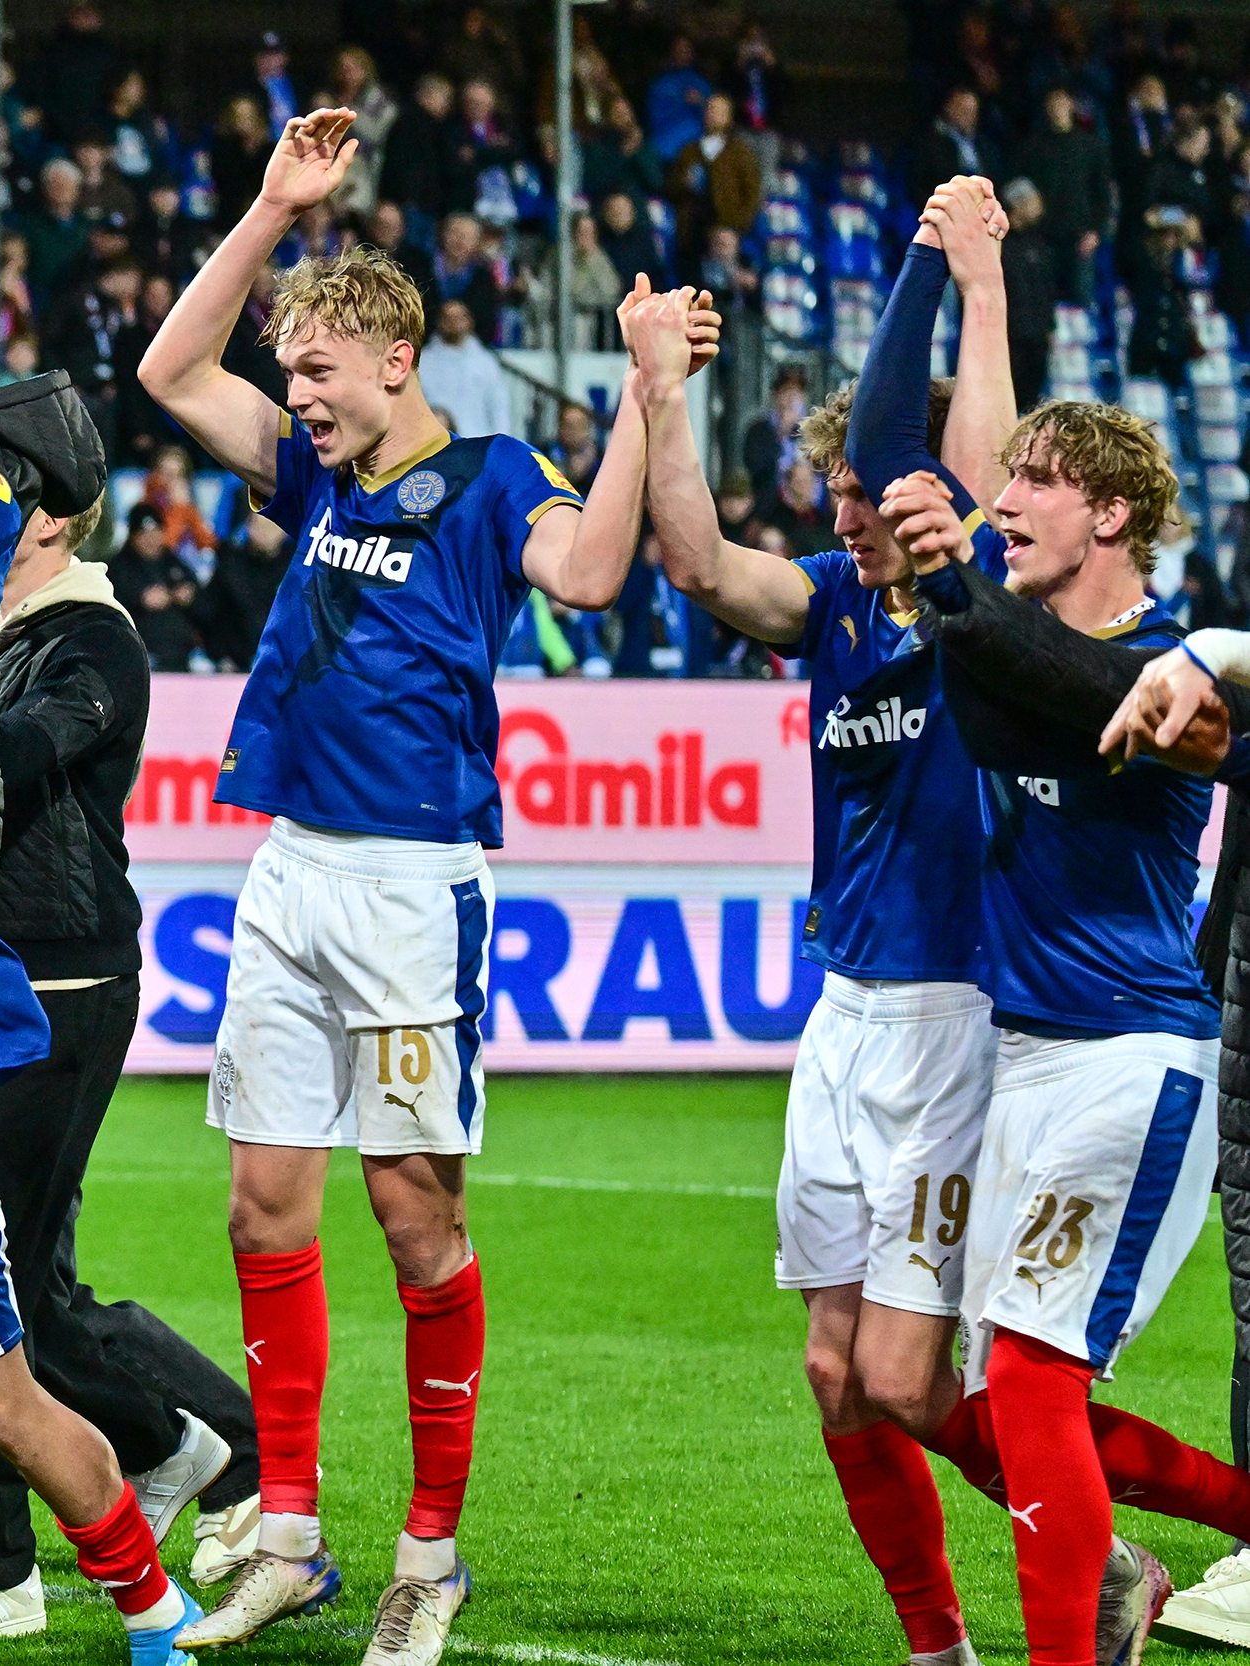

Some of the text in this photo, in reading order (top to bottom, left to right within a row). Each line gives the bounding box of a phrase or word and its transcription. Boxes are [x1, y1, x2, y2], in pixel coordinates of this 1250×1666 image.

[303, 506, 414, 583] famila
[817, 694, 928, 750] famila
[377, 1026, 432, 1085] 15
[908, 1173, 970, 1246] 19
[1015, 1190, 1095, 1269] 23
